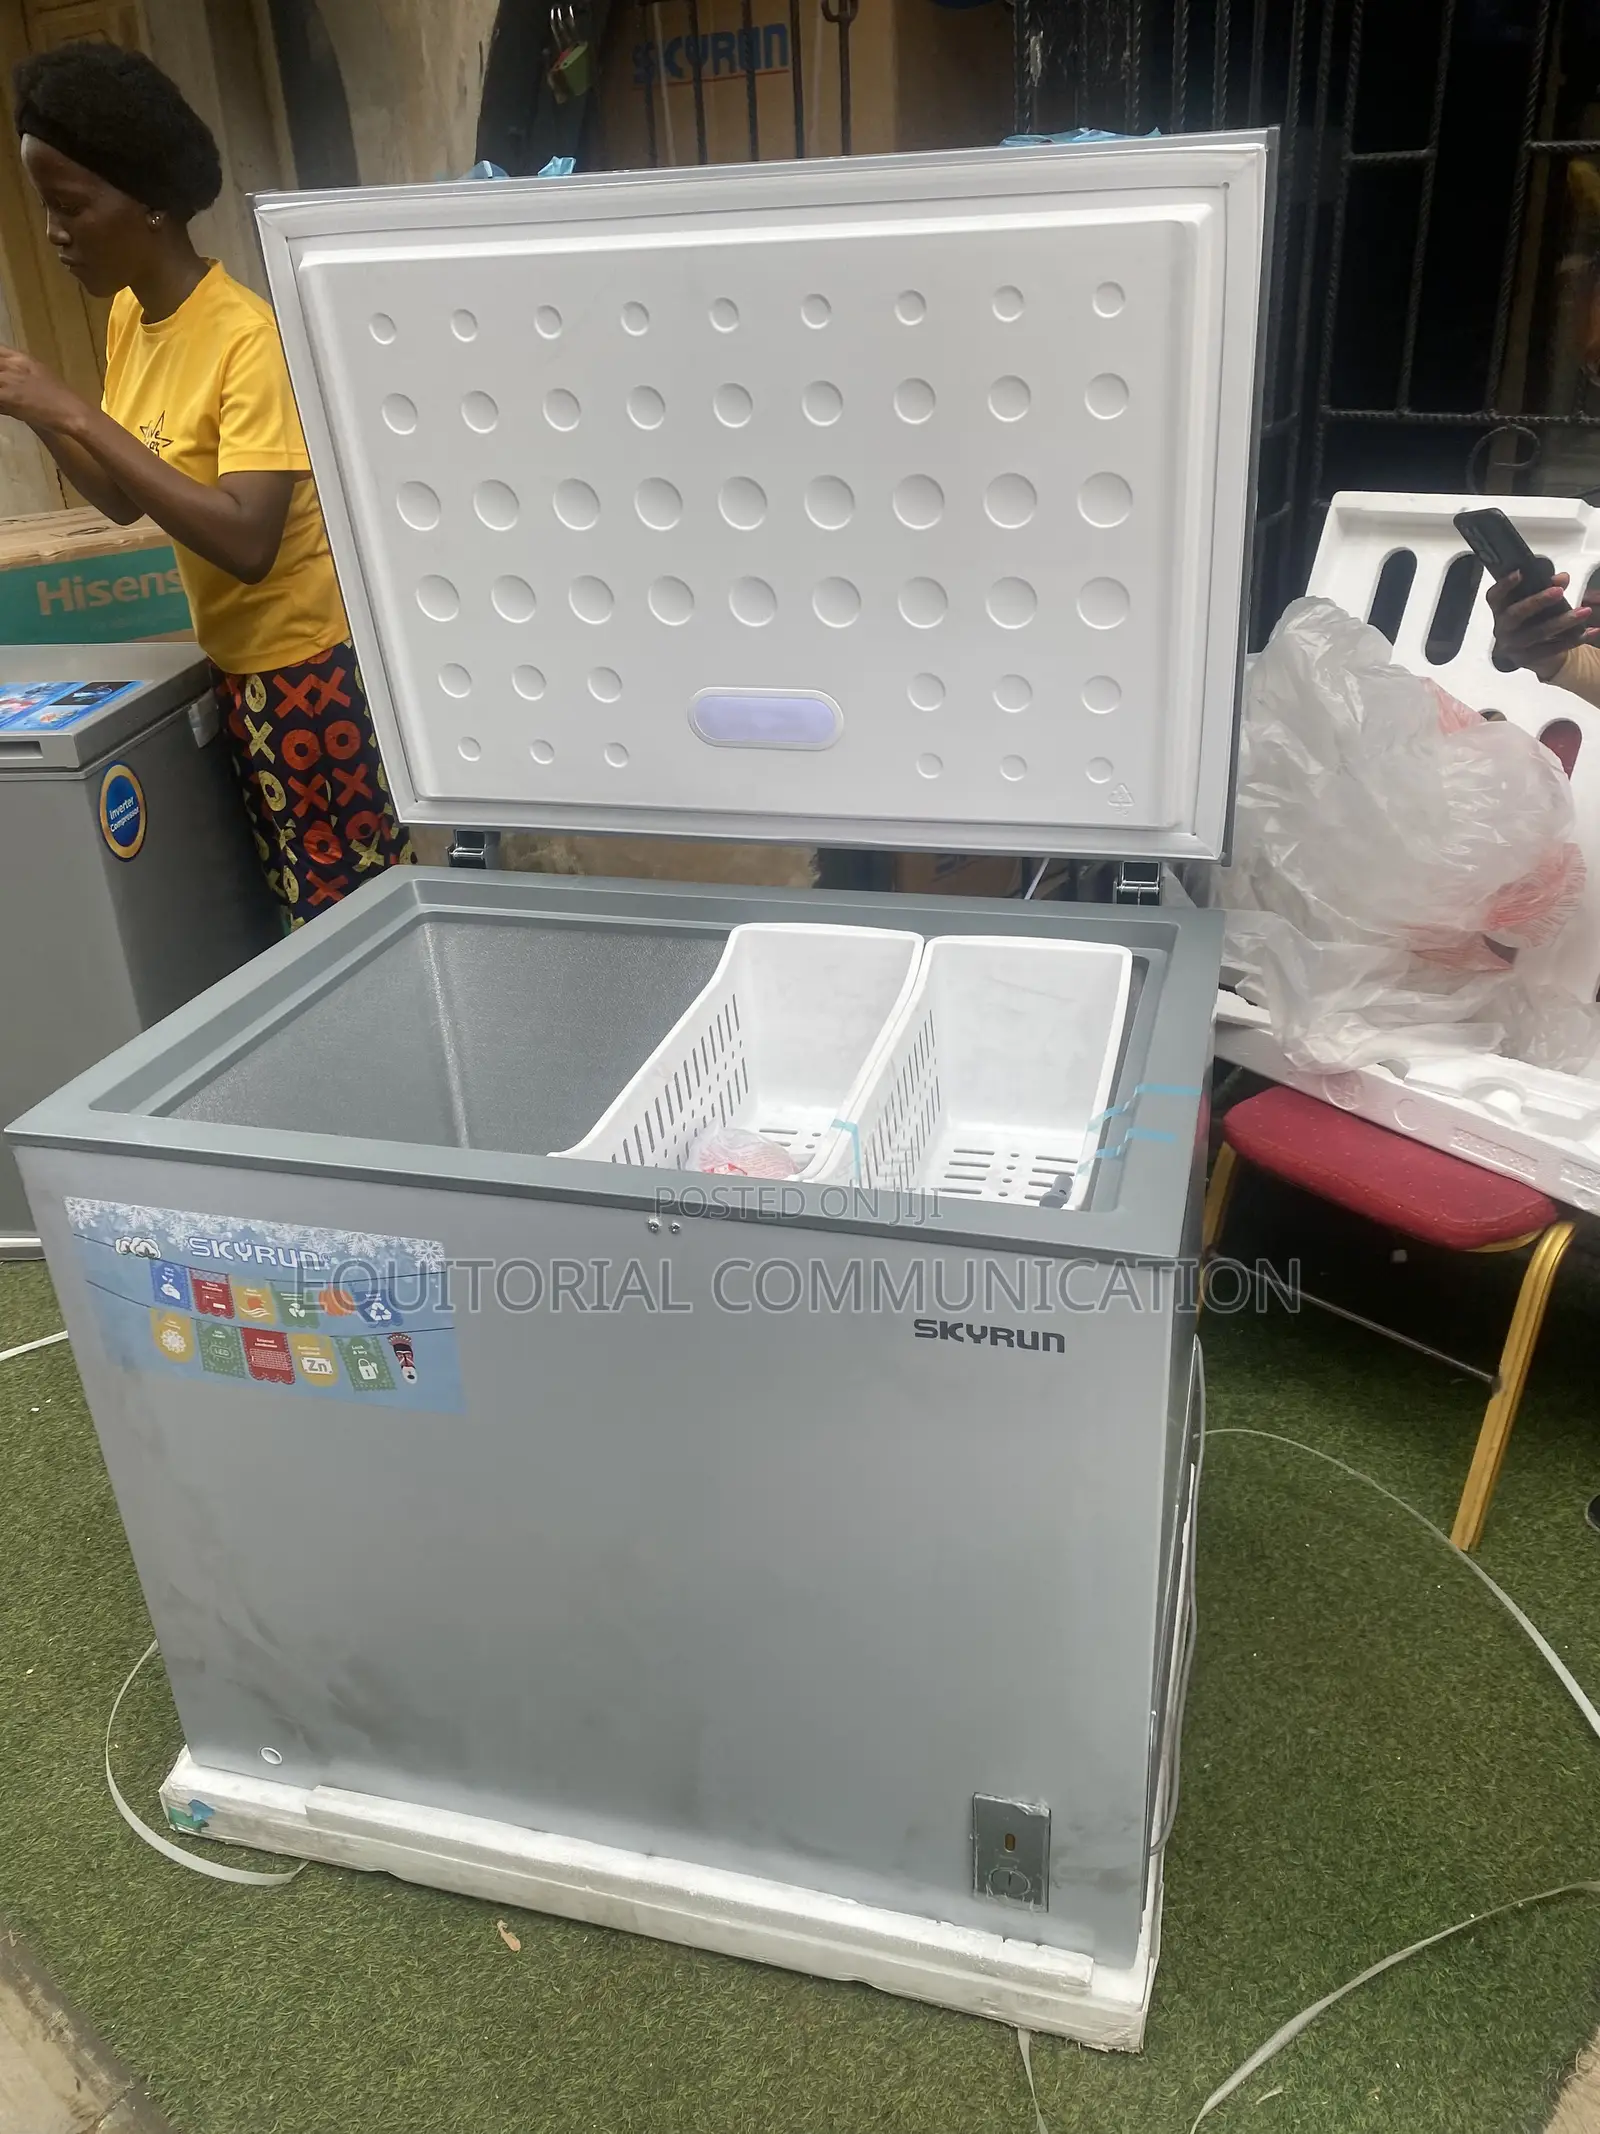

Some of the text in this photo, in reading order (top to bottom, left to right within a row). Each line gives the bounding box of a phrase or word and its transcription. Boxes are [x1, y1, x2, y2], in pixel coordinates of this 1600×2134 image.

[36, 568, 184, 615] Hisens
[110, 796, 135, 820] Inverter
[188, 1236, 324, 1270] SKYRUN
[914, 1318, 1065, 1353] SKYRUN
[306, 1359, 328, 1373] Zn
